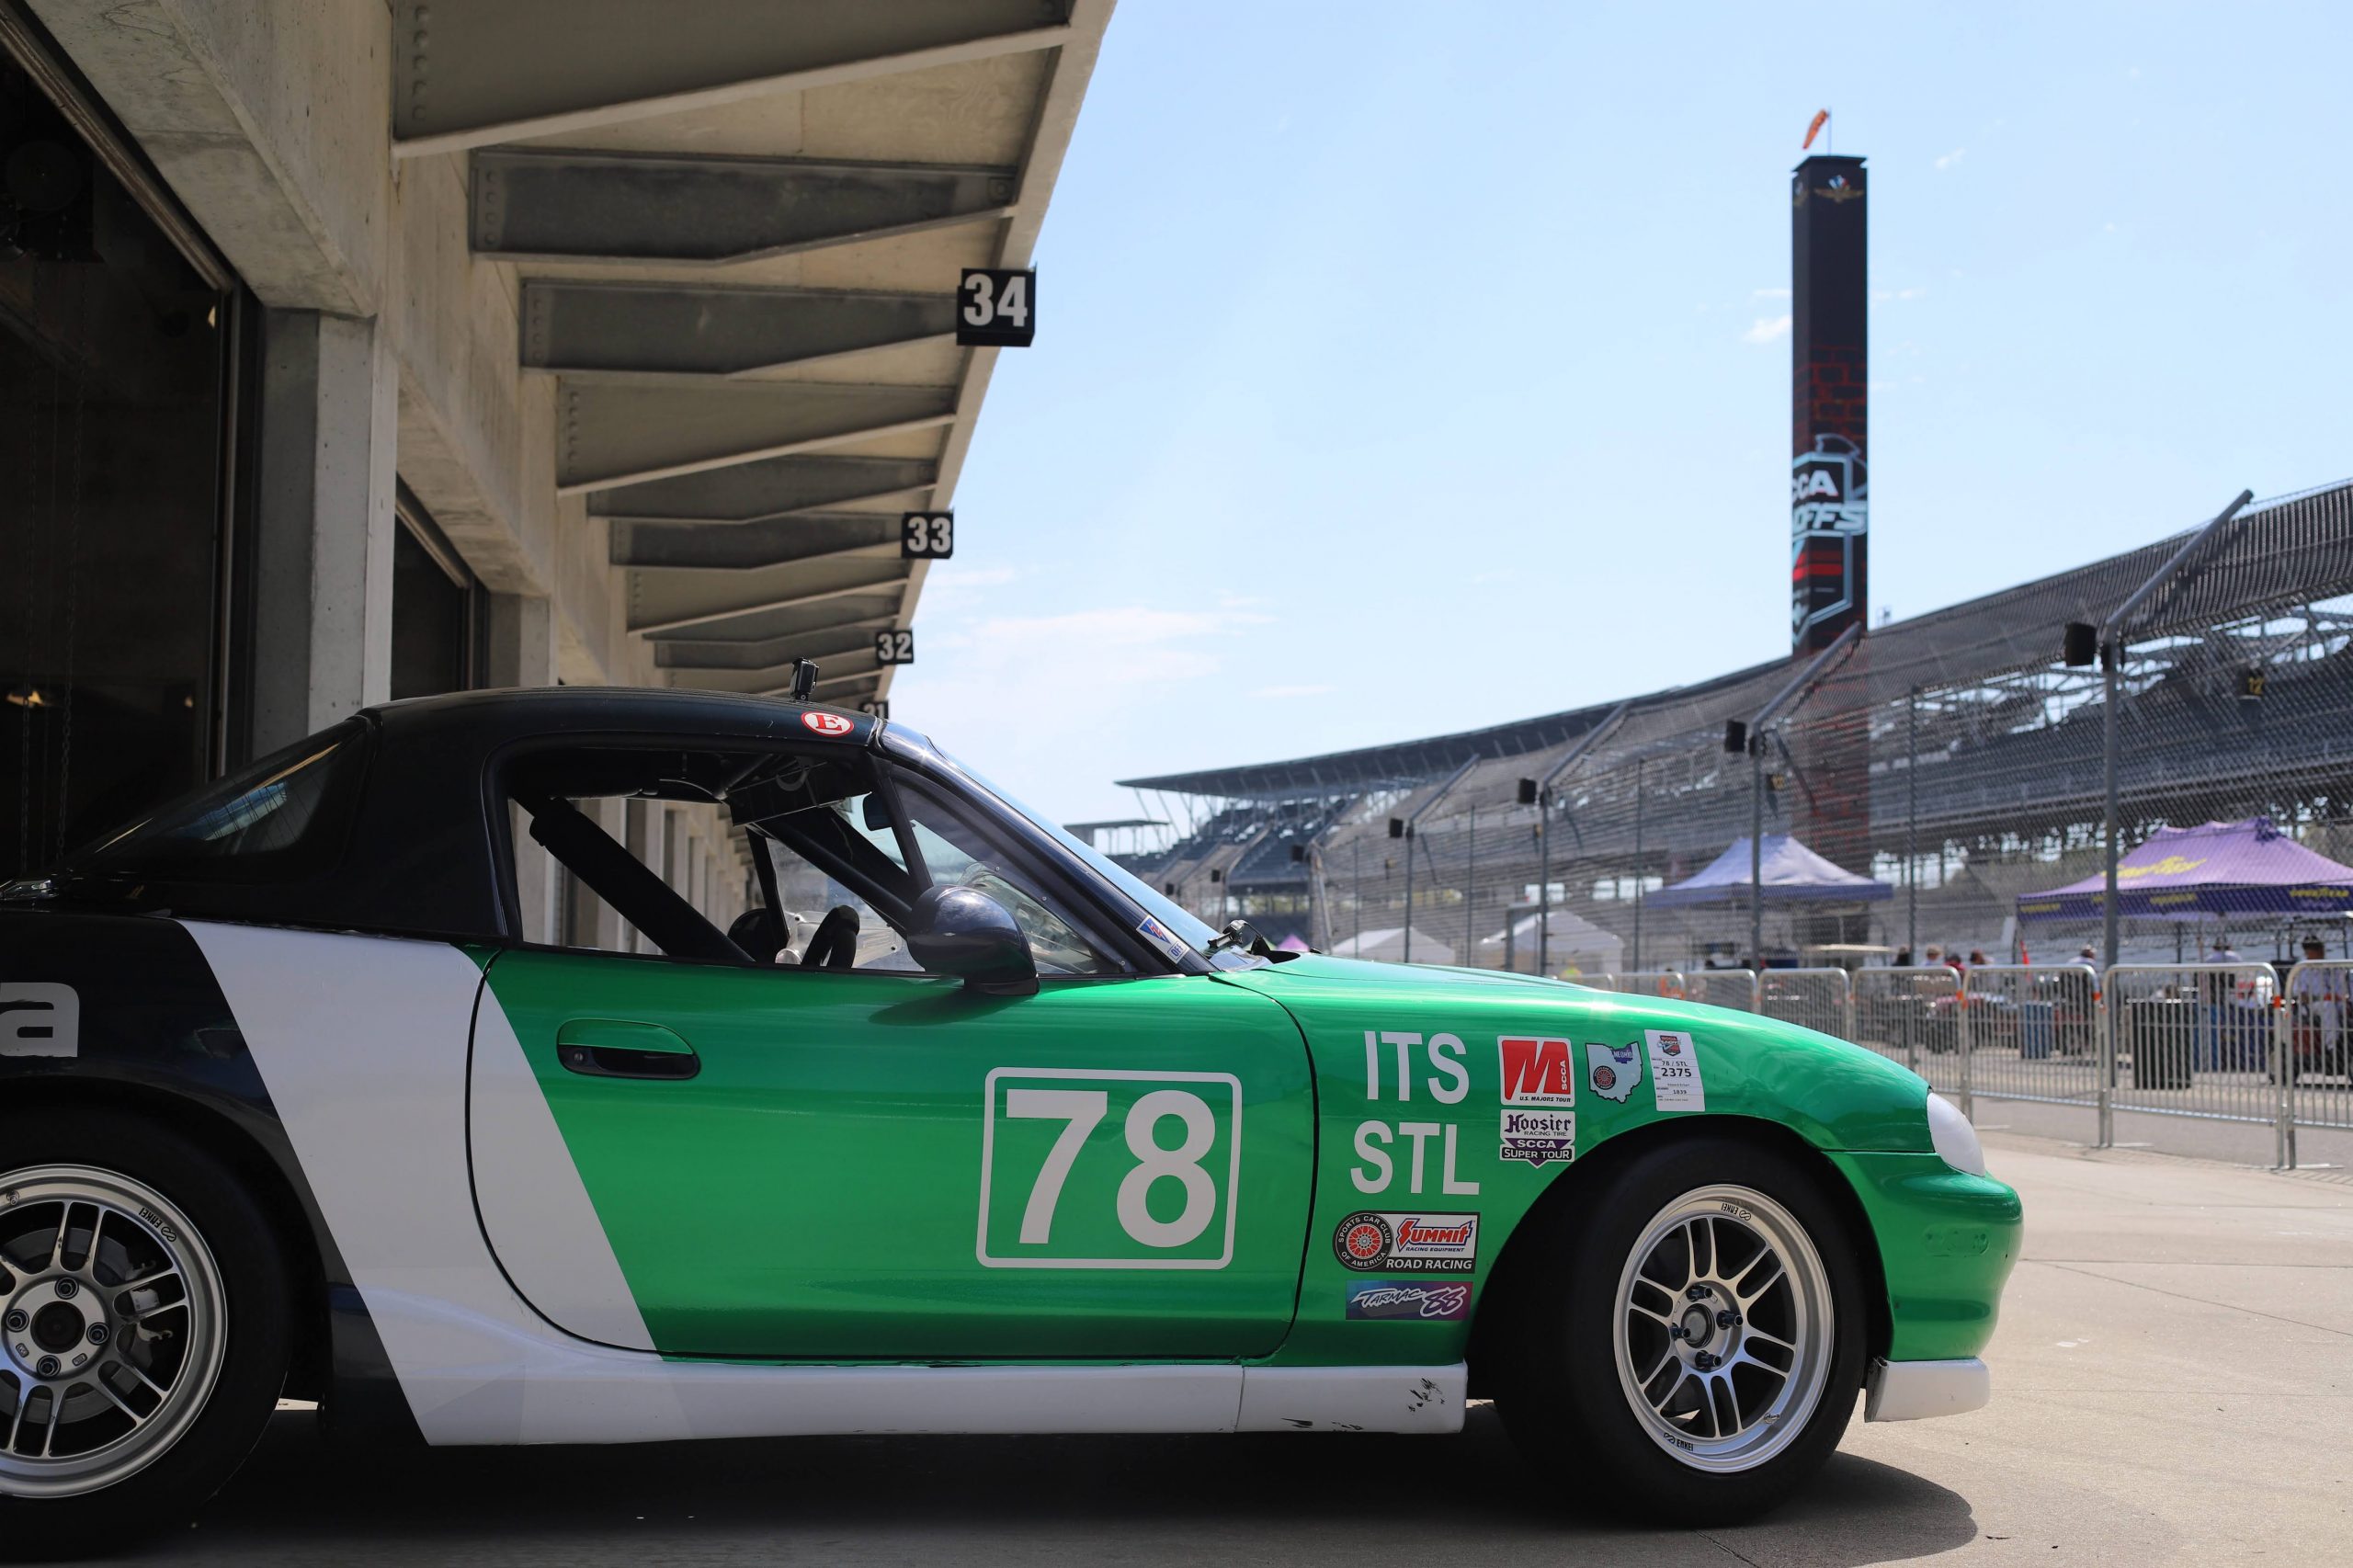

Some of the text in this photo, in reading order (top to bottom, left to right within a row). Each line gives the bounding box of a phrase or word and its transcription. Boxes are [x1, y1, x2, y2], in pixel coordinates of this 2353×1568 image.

[962, 273, 1028, 327] 34
[906, 516, 953, 553] 33
[878, 633, 913, 660] 32
[813, 713, 842, 732] E
[1170, 943, 1184, 957] OFF
[1364, 1030, 1470, 1105] ITS
[1559, 1060, 1568, 1091] SCCA
[1661, 1067, 1692, 1077] 2375
[1504, 1113, 1572, 1132] Hoosier
[1350, 1119, 1481, 1196] STL
[1504, 1148, 1570, 1159] SUPER TOUR
[1517, 1139, 1557, 1149] SCCA
[1006, 1088, 1216, 1247] 78
[1338, 1215, 1391, 1244] SPORTS CAR CLUB
[1341, 1251, 1387, 1267] OF AMERICA
[1385, 1258, 1472, 1269] ROAD RACING
[1420, 1286, 1467, 1317] 88
